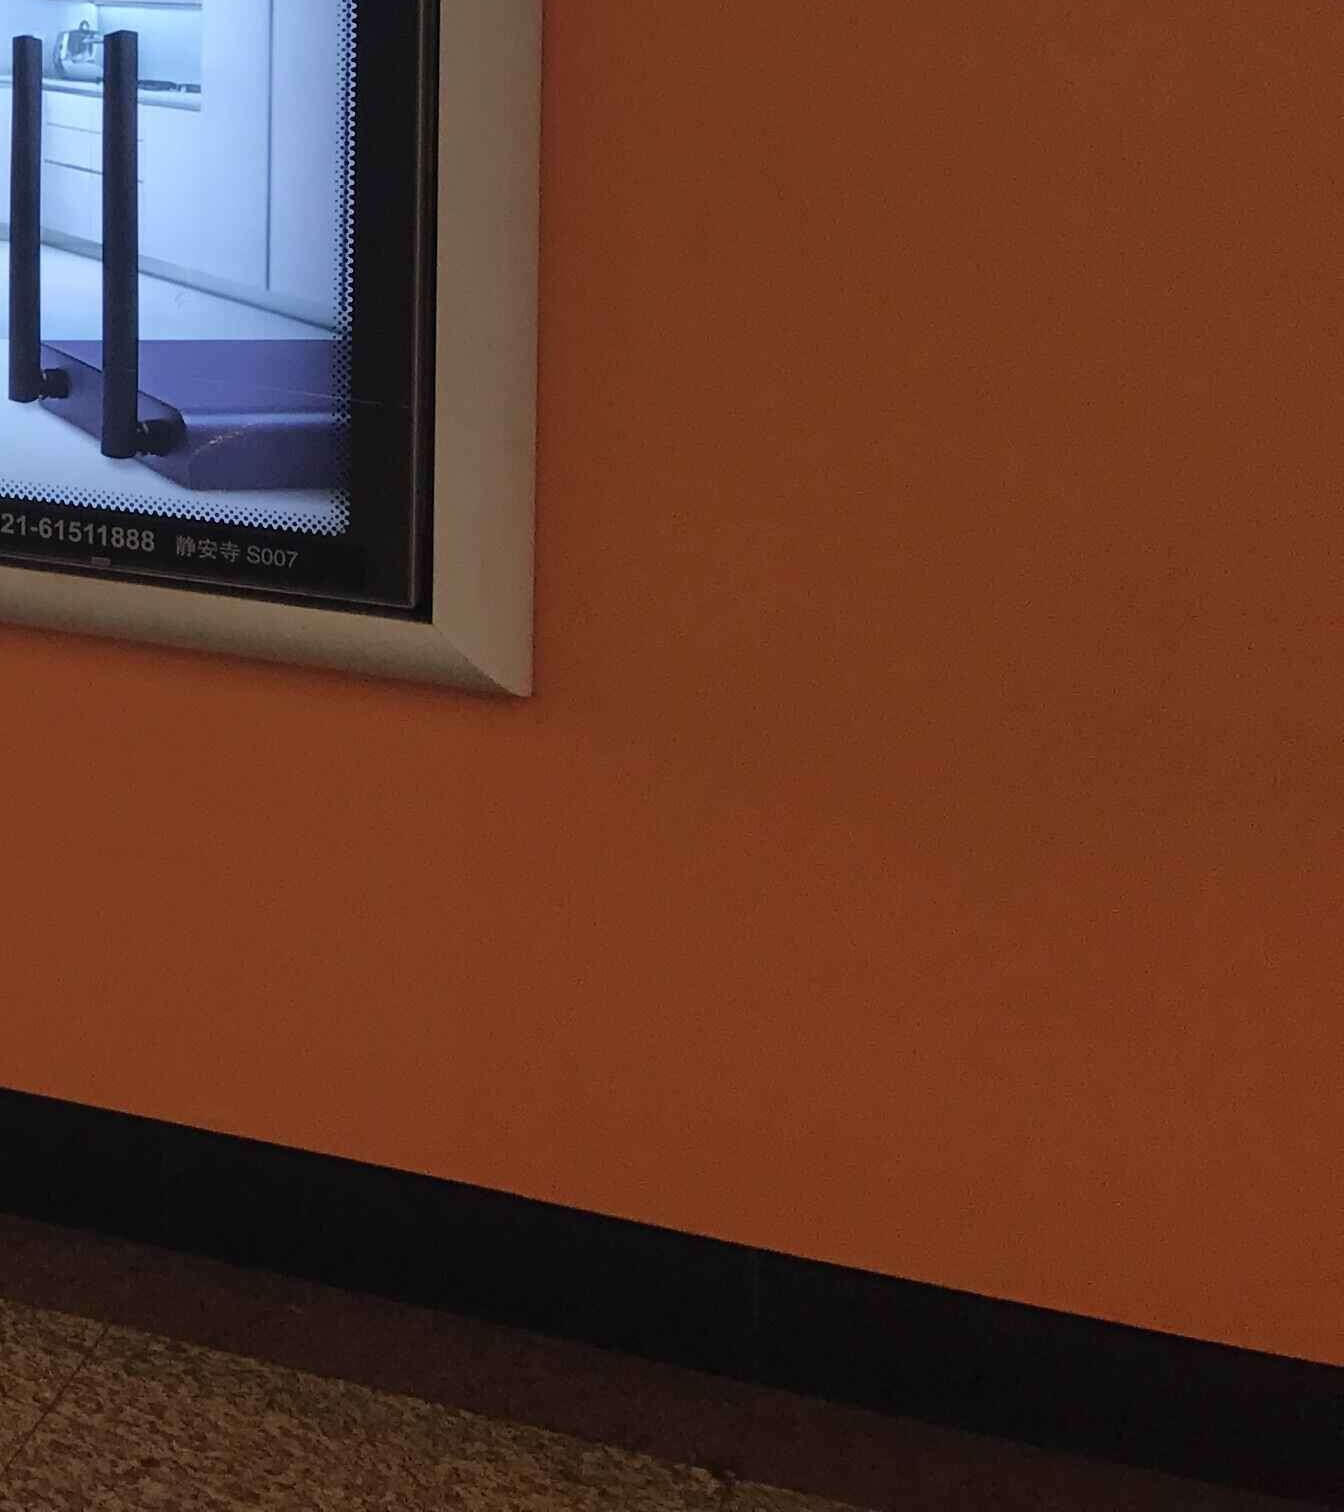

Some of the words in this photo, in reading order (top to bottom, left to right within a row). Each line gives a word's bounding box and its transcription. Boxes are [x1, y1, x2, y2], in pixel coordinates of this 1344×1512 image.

[175, 534, 241, 562] 静安寺
[246, 546, 299, 569] S007
